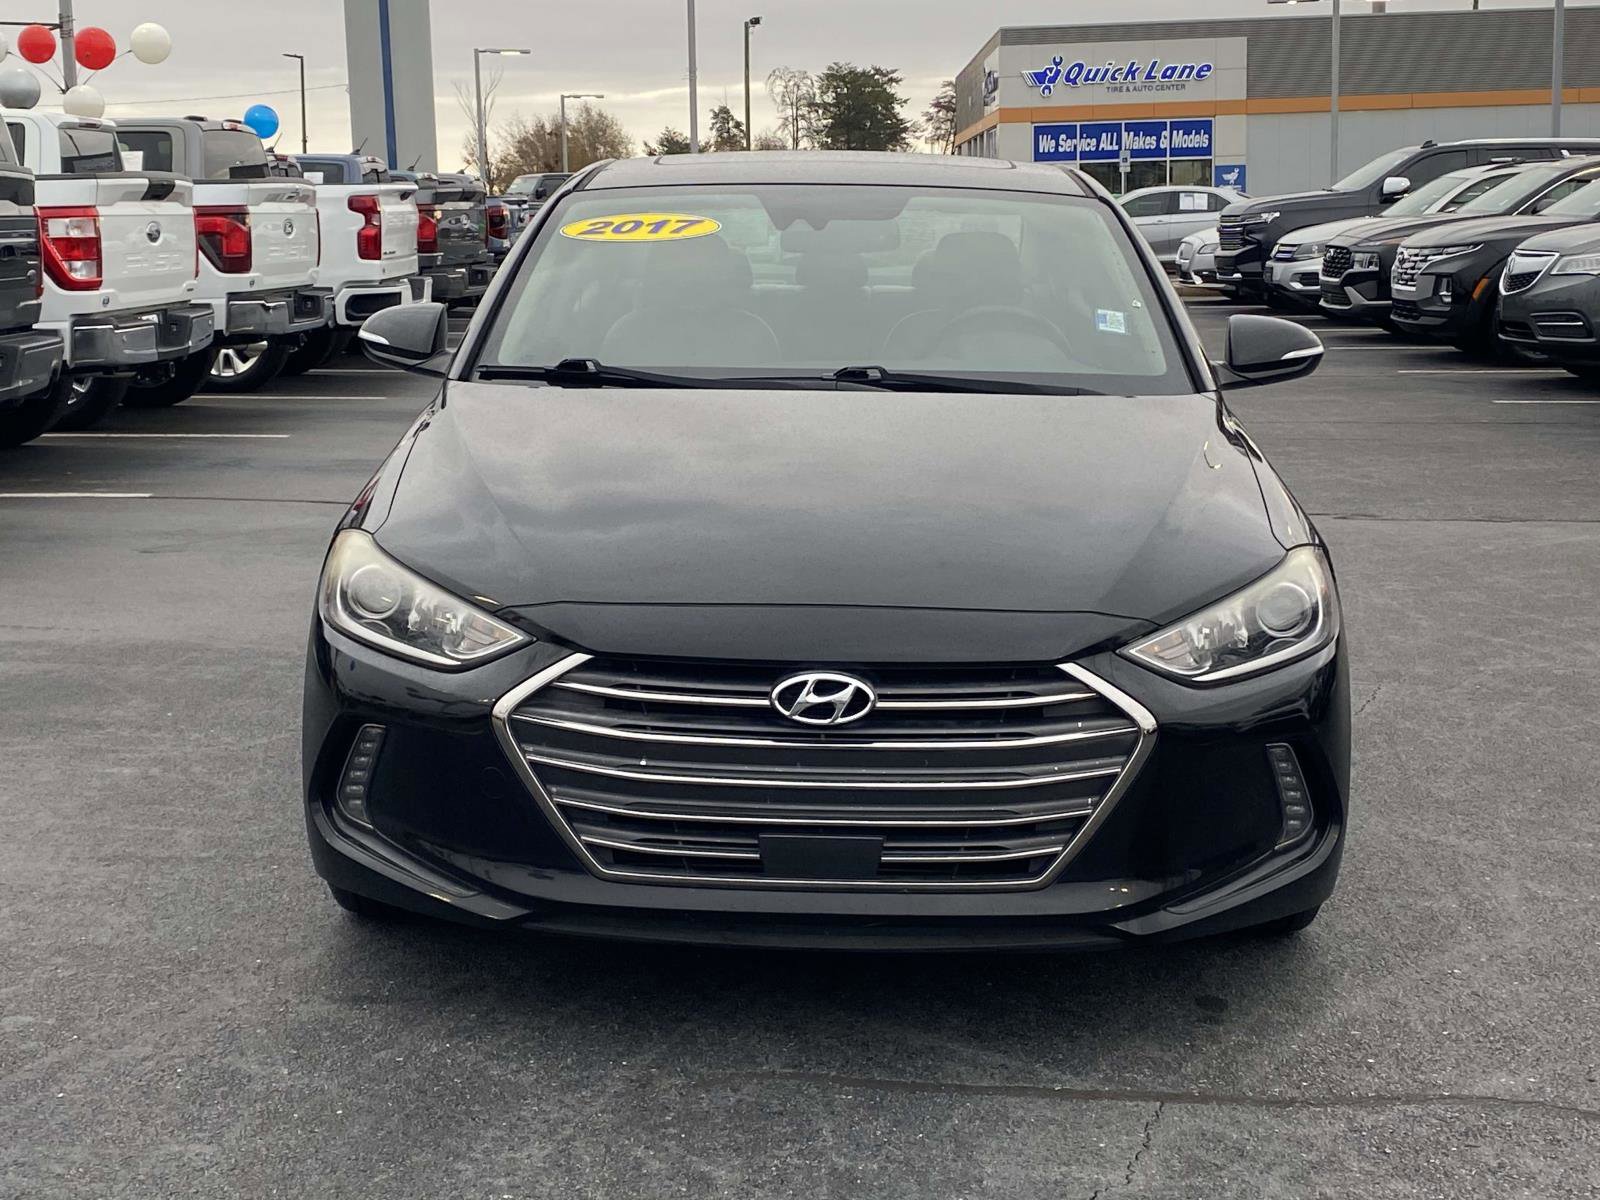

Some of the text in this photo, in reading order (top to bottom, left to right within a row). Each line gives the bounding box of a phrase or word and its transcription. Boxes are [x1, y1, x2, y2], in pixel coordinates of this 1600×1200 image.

[1064, 59, 1212, 86] Quick Lane
[1106, 83, 1186, 93] TIRE & AUTO CENTER
[1038, 129, 1209, 153] We Service ALL Makes & Models
[577, 219, 704, 236] 2017
